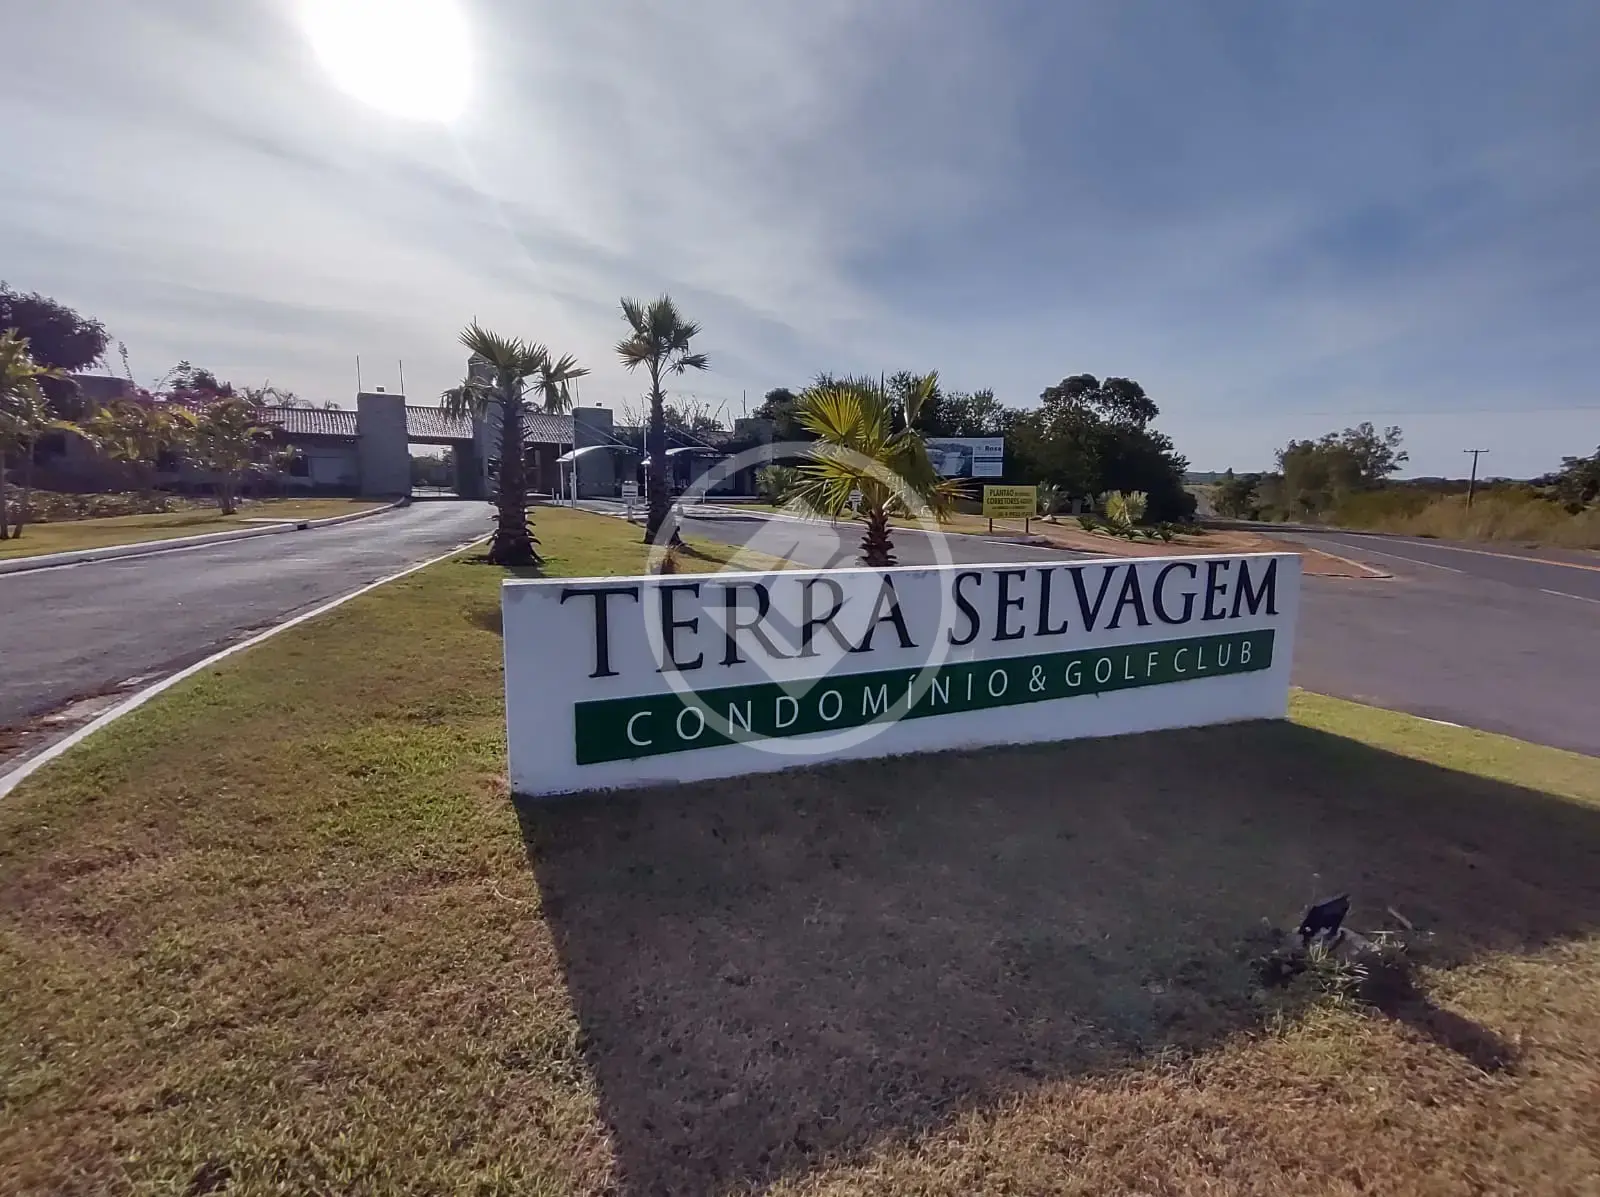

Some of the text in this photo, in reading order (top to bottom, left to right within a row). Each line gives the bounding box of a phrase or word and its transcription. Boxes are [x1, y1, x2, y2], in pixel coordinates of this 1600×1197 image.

[560, 558, 1279, 678] TERRA SELVAGEM
[627, 640, 1252, 747] CONDOMÍNIO & GOLF CLUB
